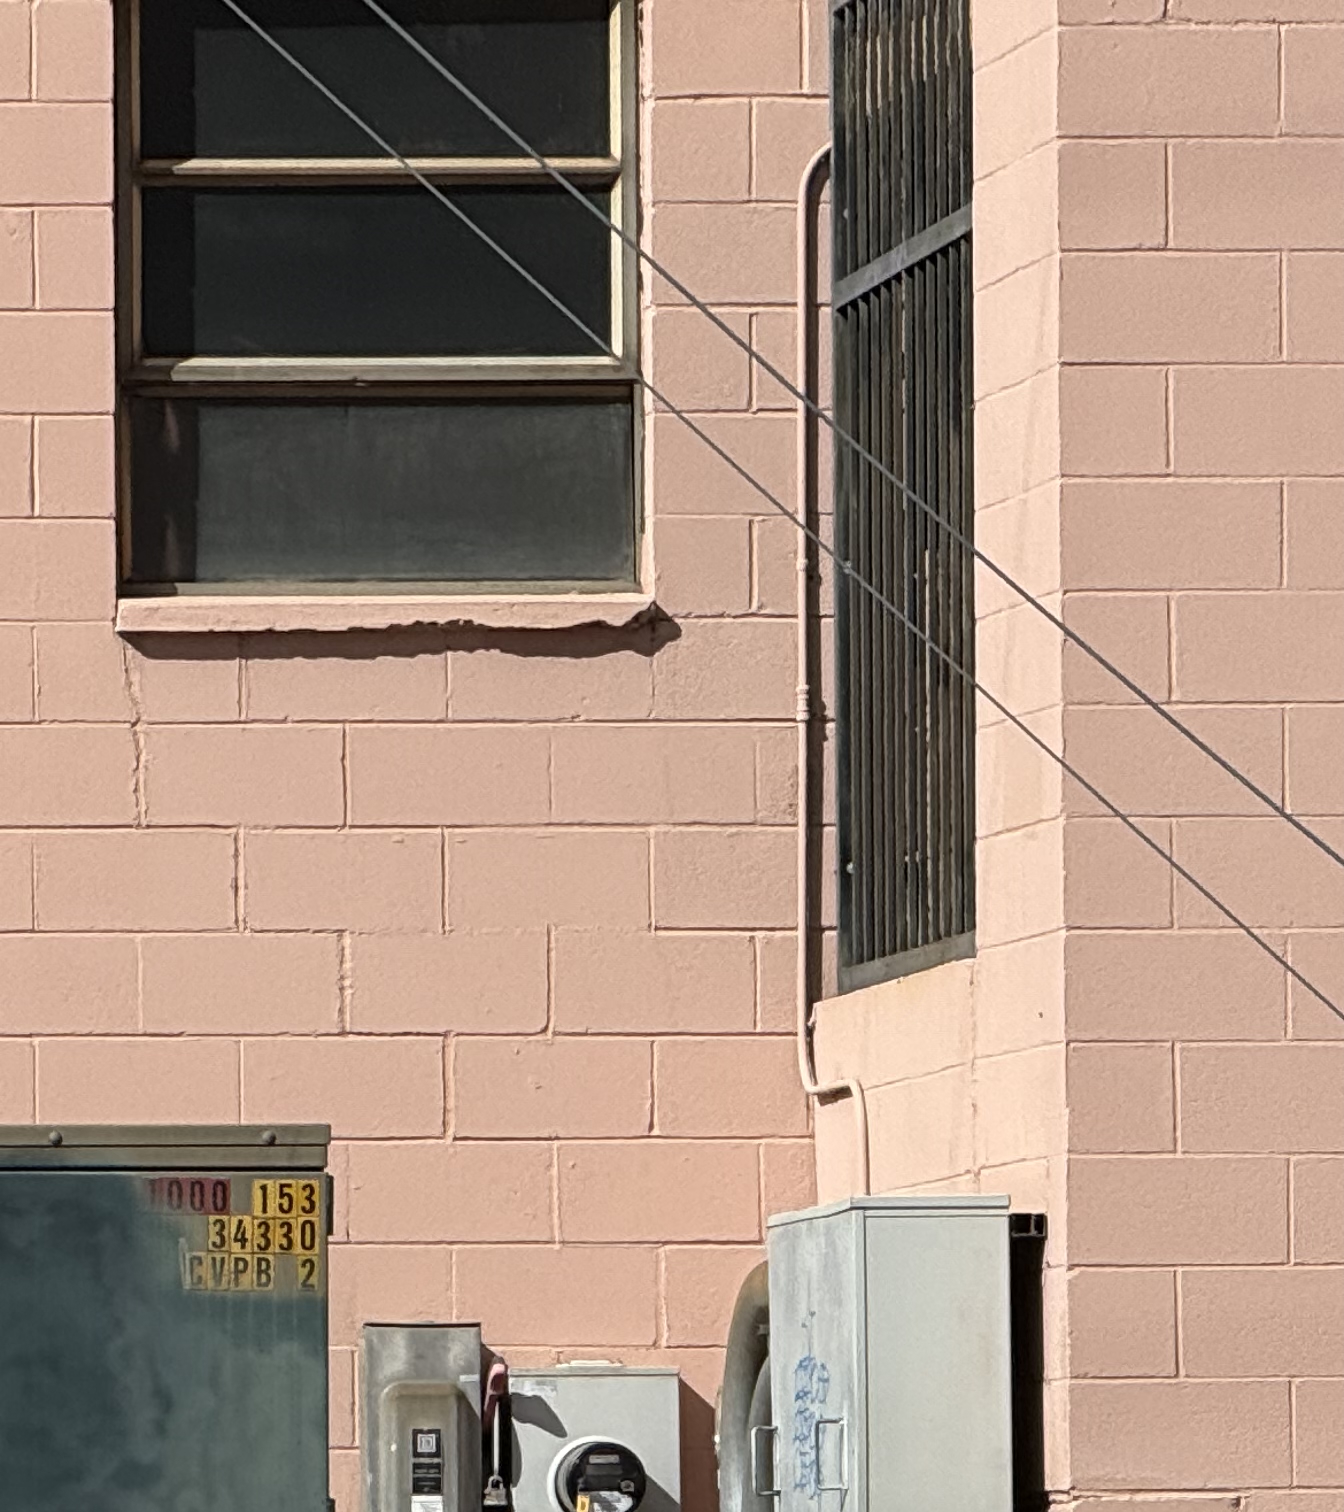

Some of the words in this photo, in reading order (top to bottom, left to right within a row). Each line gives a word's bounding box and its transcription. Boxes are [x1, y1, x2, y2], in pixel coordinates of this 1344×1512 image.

[259, 1183, 316, 1214] 153
[211, 1219, 315, 1251] 34330
[301, 1258, 315, 1289] 2
